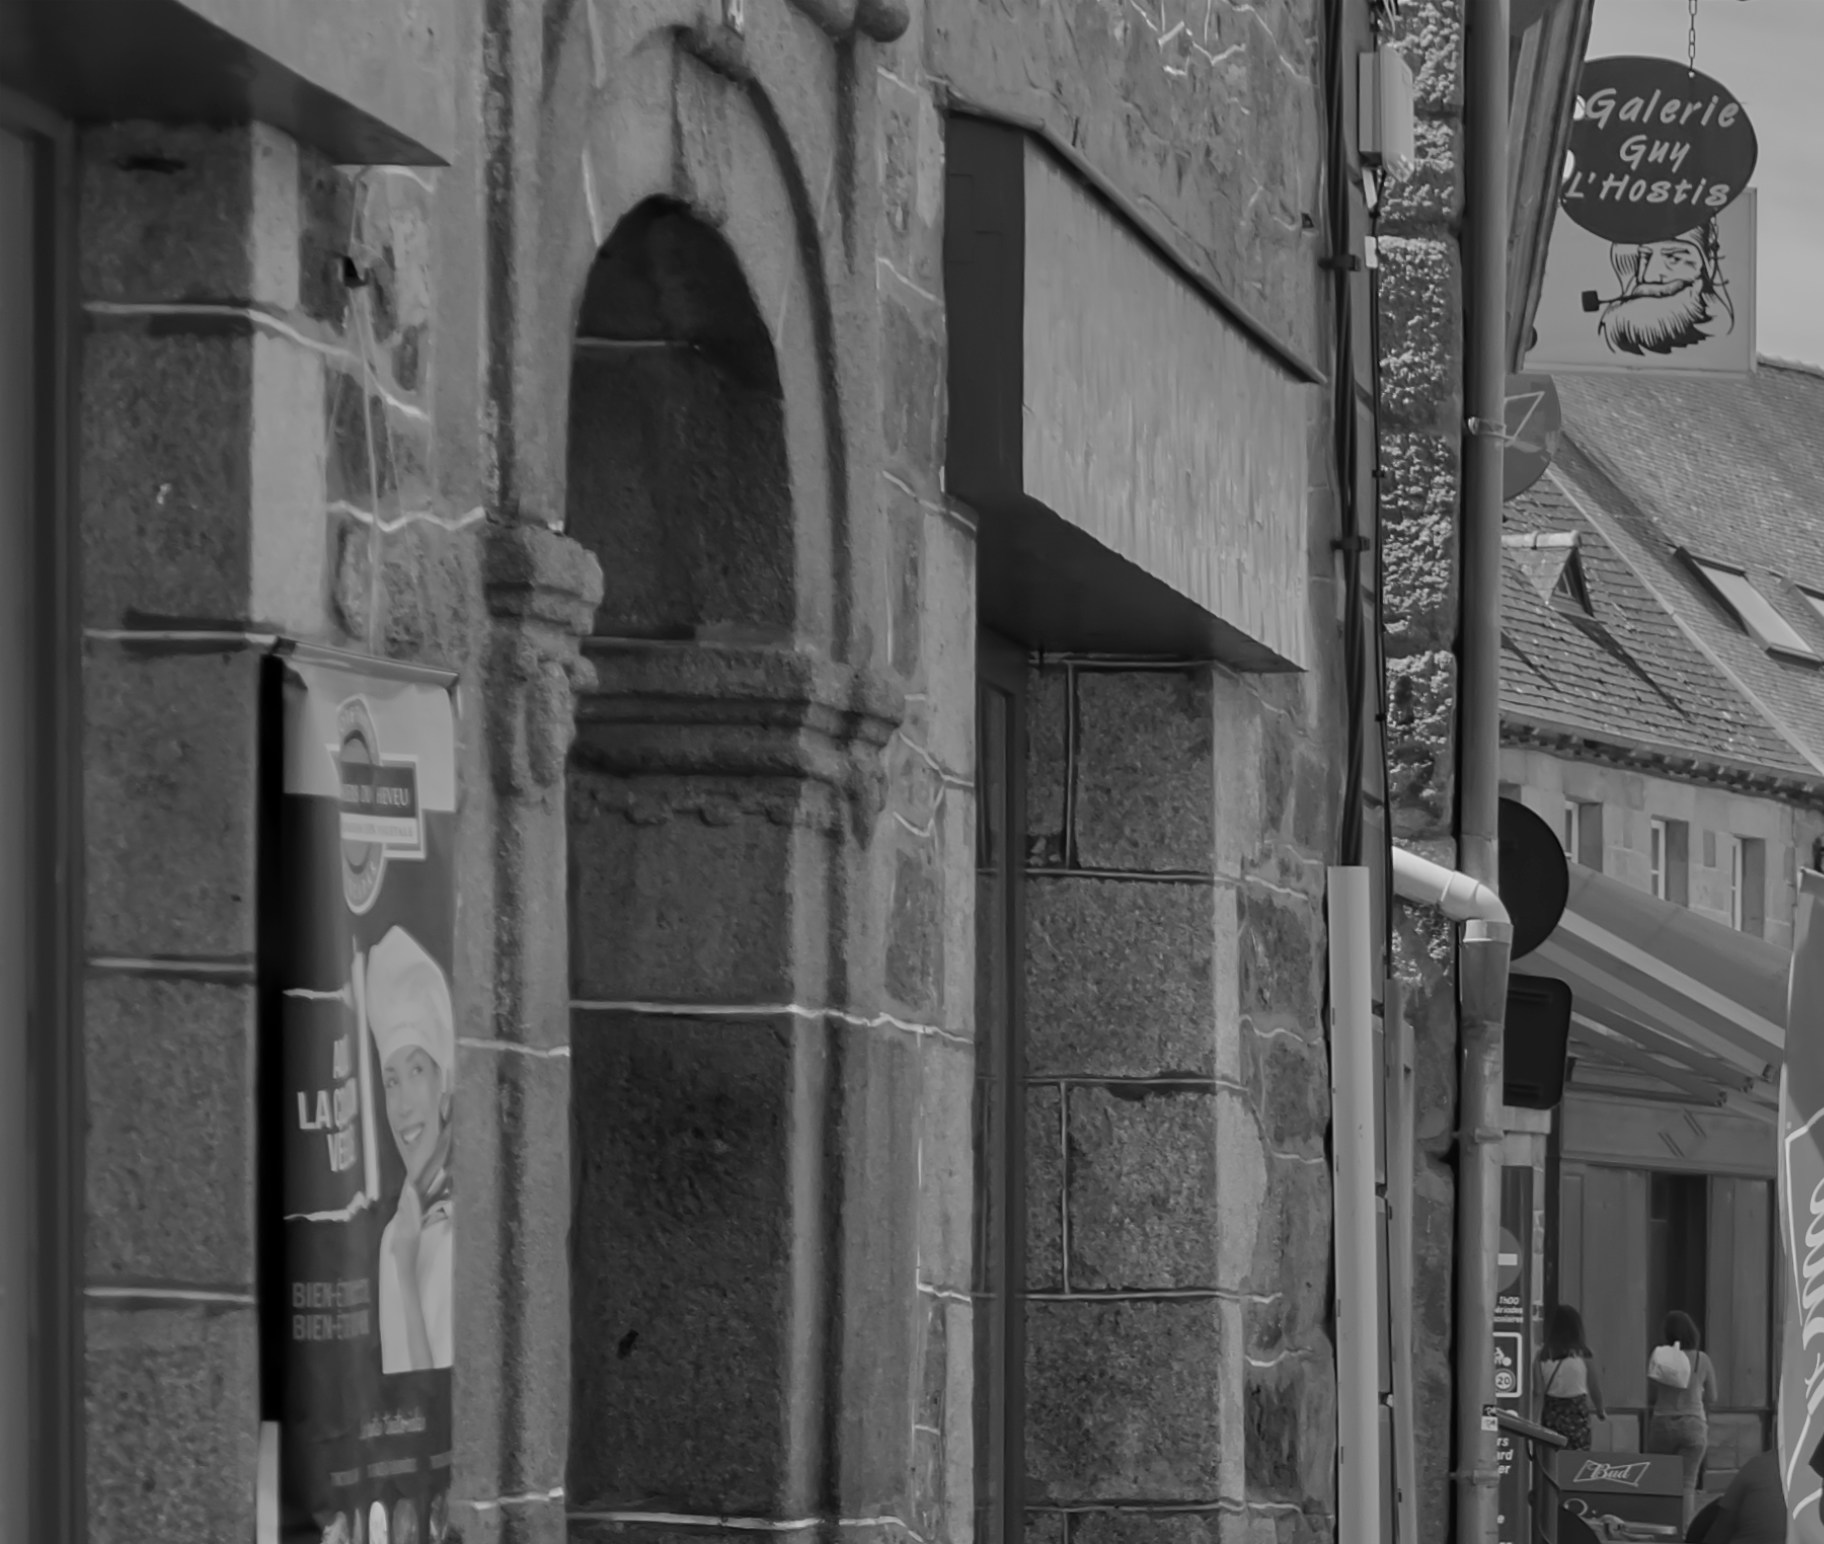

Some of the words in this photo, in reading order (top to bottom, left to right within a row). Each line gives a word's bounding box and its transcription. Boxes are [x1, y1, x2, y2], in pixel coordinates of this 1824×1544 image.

[1585, 87, 1740, 131] Galerie
[1619, 134, 1691, 174] Guy
[1564, 170, 1731, 207] L'Hostis
[1586, 1460, 1632, 1482] Bud
